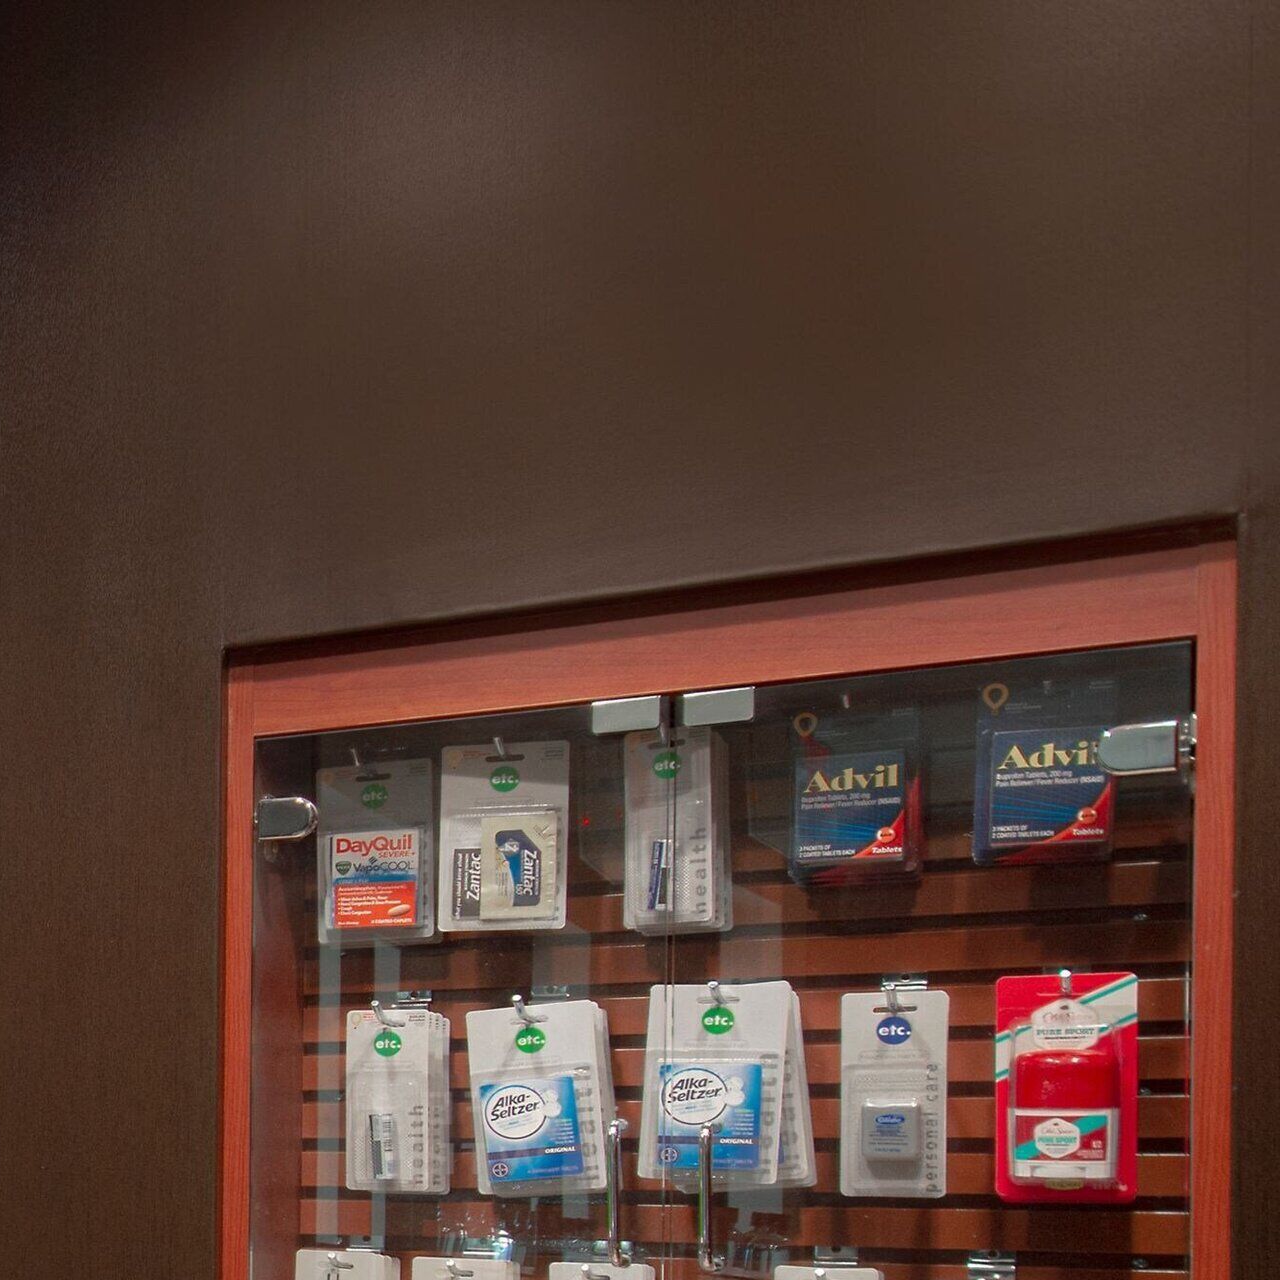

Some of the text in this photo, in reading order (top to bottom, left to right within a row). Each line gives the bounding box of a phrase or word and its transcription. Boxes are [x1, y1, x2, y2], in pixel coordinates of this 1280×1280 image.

[491, 773, 520, 785] etc.
[803, 763, 899, 794] Advil
[1072, 828, 1105, 837] Tablets
[335, 834, 413, 857] DayQuil
[872, 846, 903, 855] Tablets
[352, 861, 415, 874] VapoCOOL
[523, 849, 538, 896] Zantac
[690, 827, 707, 914] health
[466, 852, 482, 901] Zantac
[703, 1015, 734, 1027] etc.
[878, 1024, 912, 1037] etc.
[1036, 1027, 1095, 1036] PURE SPORT
[375, 1038, 402, 1049] etc.
[517, 1034, 546, 1047] etc.
[672, 1077, 714, 1092] Alka-
[666, 1086, 723, 1104] Seltzer
[492, 1093, 531, 1111] Alka-
[490, 1101, 541, 1122] Seltzer
[925, 1063, 942, 1194] personal care
[1037, 1135, 1077, 1145] PURE SPORT
[544, 1146, 576, 1155] ORIGINAL
